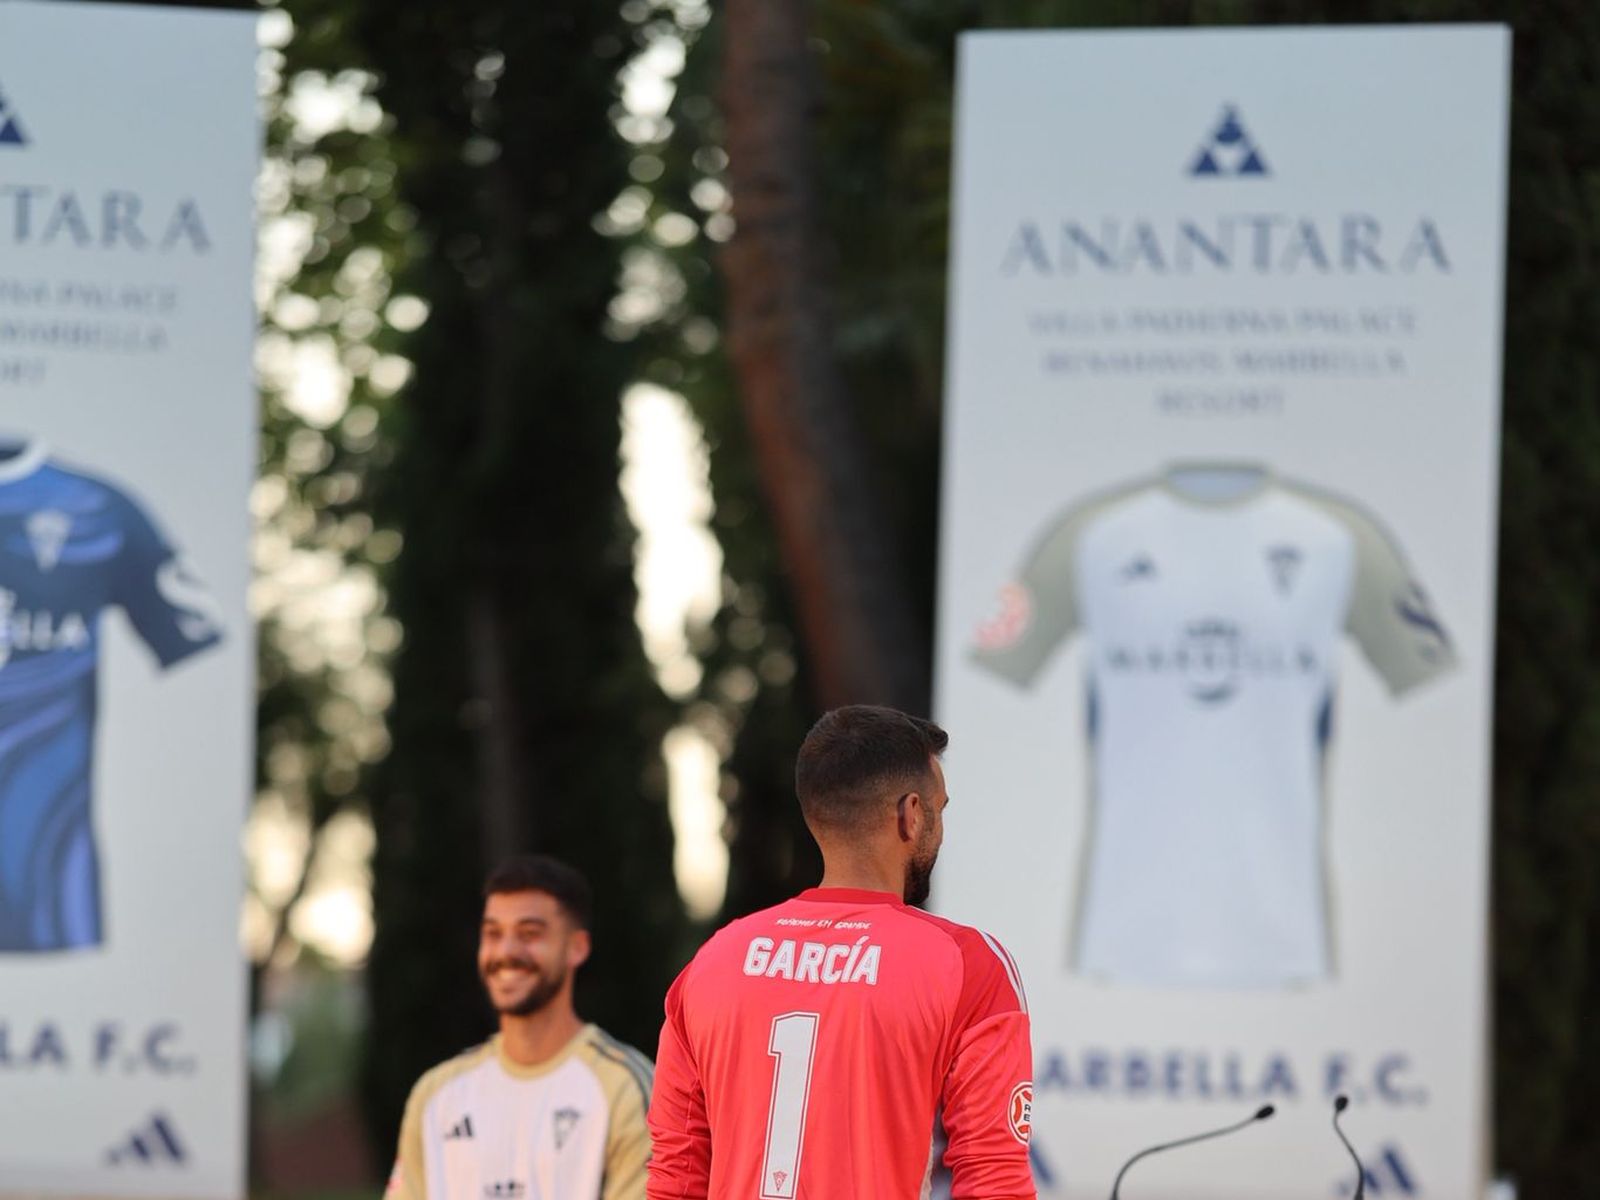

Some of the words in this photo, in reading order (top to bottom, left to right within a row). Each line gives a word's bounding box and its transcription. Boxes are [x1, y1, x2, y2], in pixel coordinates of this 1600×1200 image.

[1003, 215, 1451, 274] ANANTARA
[743, 935, 882, 985] GARCÍA
[92, 1019, 198, 1075] F.C.
[1035, 1046, 1295, 1098] ARBELLA
